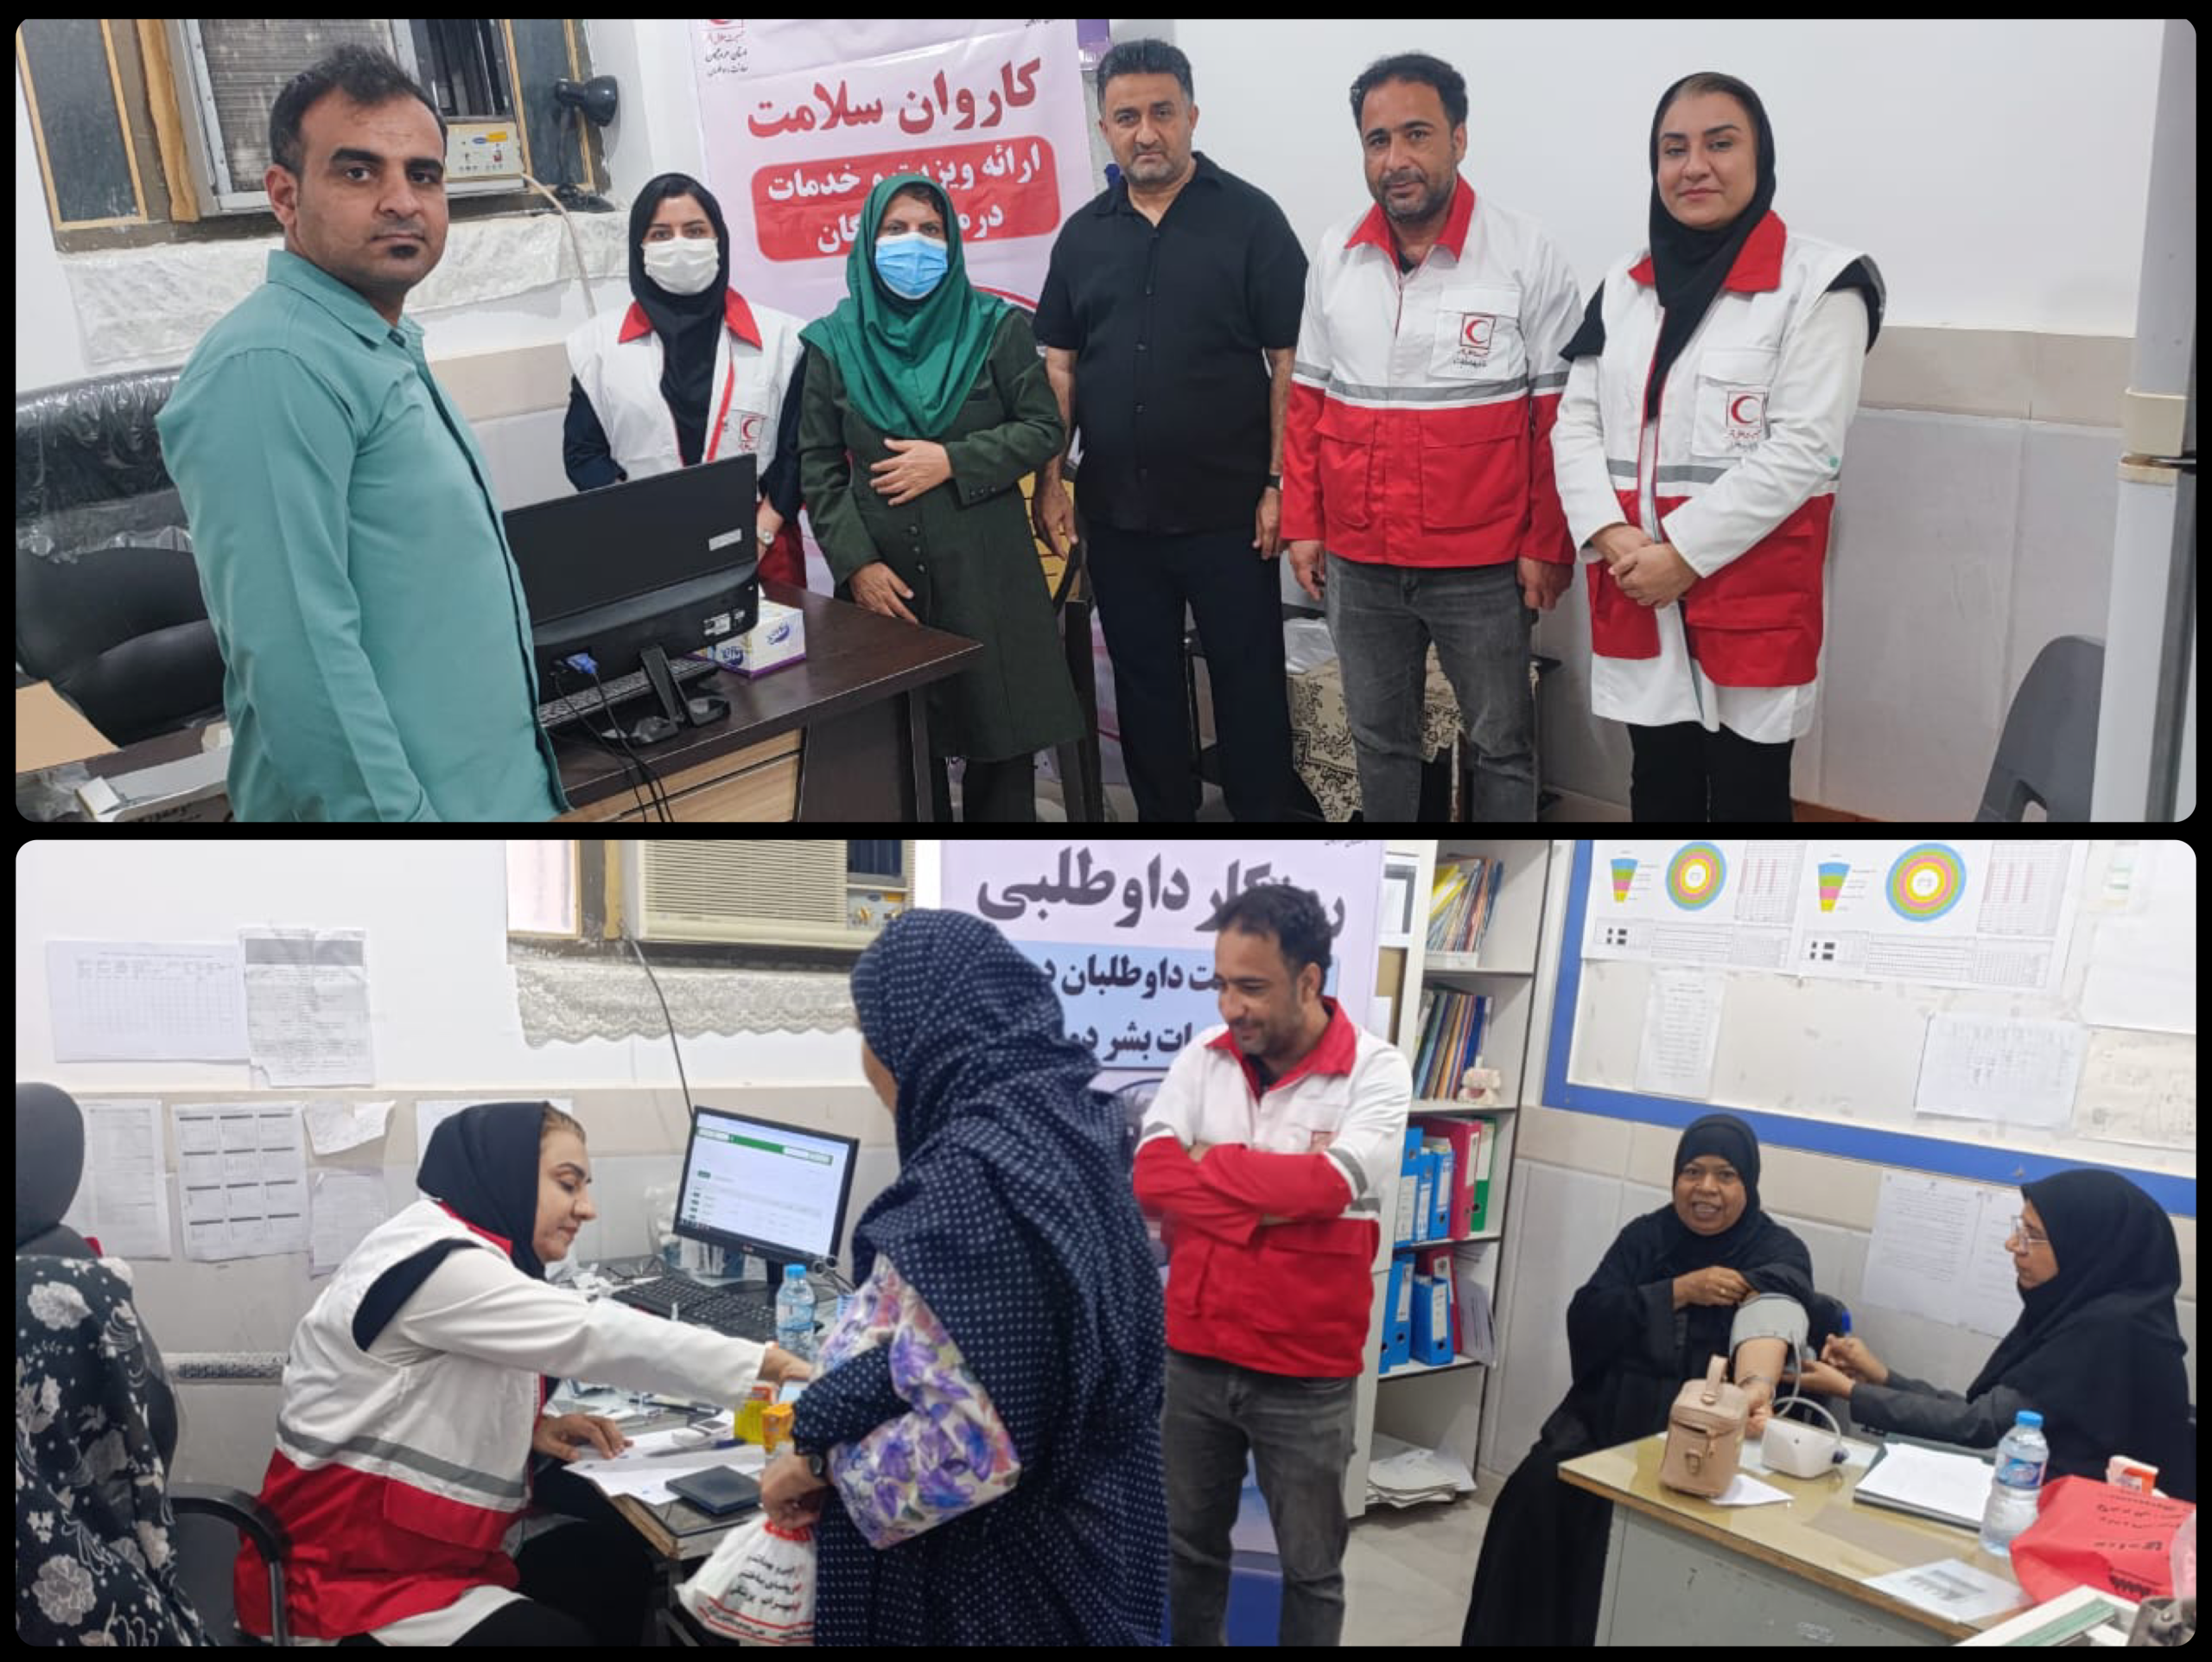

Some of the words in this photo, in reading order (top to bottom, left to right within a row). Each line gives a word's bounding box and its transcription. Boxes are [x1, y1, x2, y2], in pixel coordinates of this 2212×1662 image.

[747, 80, 883, 139] سلامت
[899, 56, 1041, 135] کاروان
[767, 163, 861, 201] خدمات
[981, 142, 1040, 184] ارائه
[977, 845, 1190, 929] داوطلبی
[1061, 953, 1184, 1000] داوطلبان
[1102, 1021, 1152, 1062] بشر
